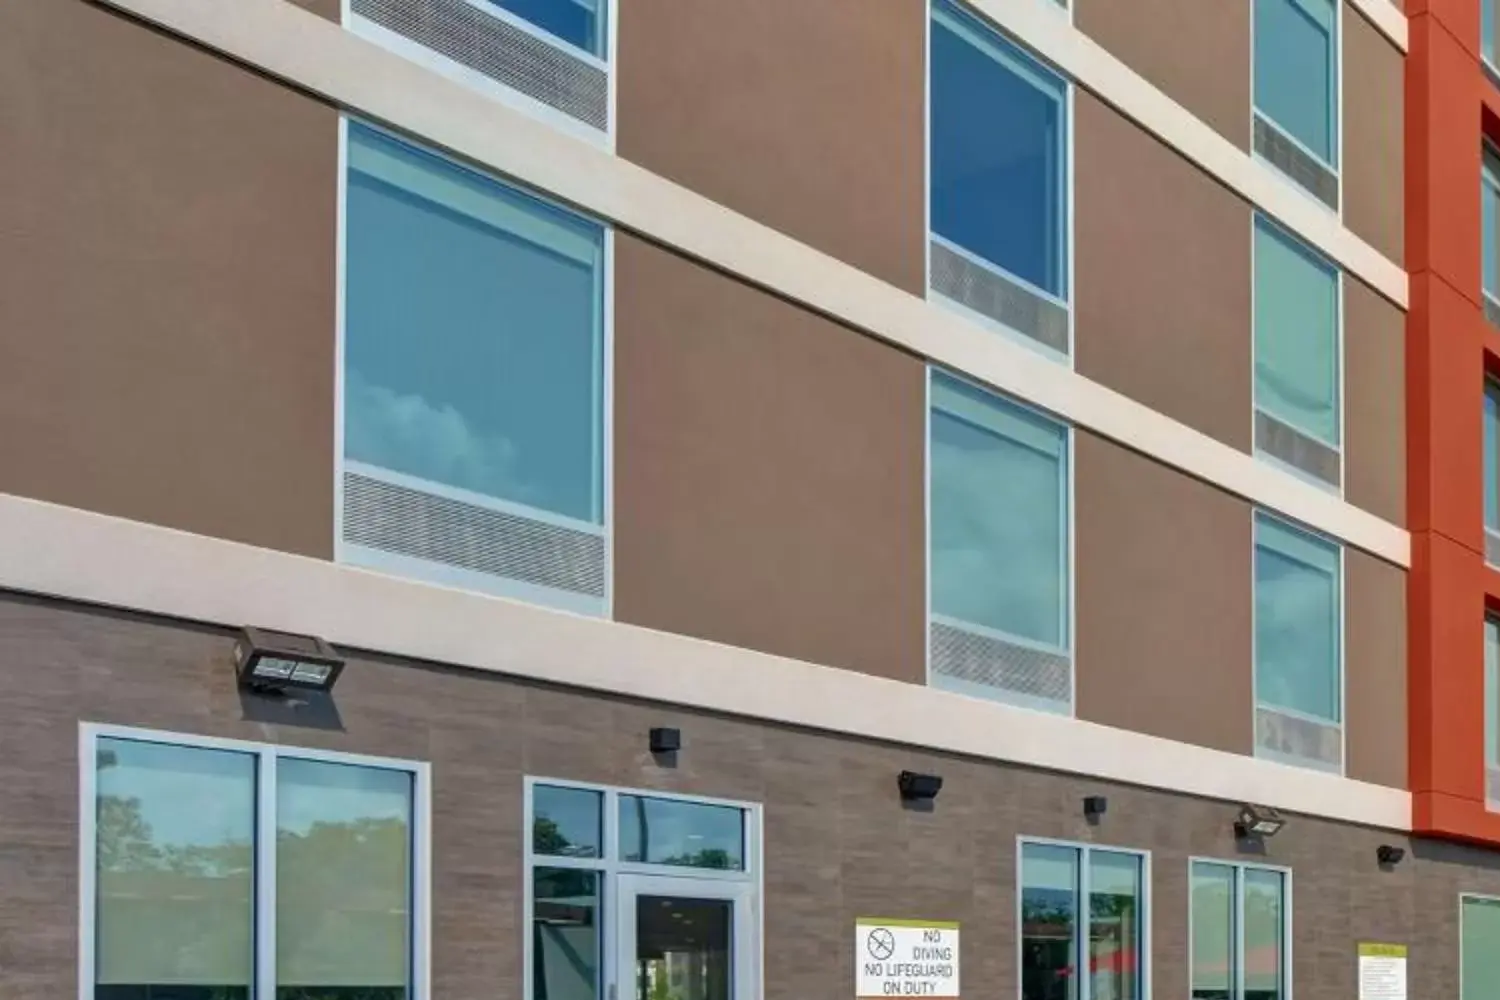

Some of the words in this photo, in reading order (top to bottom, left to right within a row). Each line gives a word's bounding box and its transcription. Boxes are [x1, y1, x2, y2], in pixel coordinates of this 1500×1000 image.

[923, 930, 941, 943] NO
[913, 946, 953, 960] DIVING
[864, 963, 883, 977] NO
[886, 963, 953, 978] LIFEGUARD
[883, 981, 901, 995] ON
[904, 981, 937, 995] DUTY
